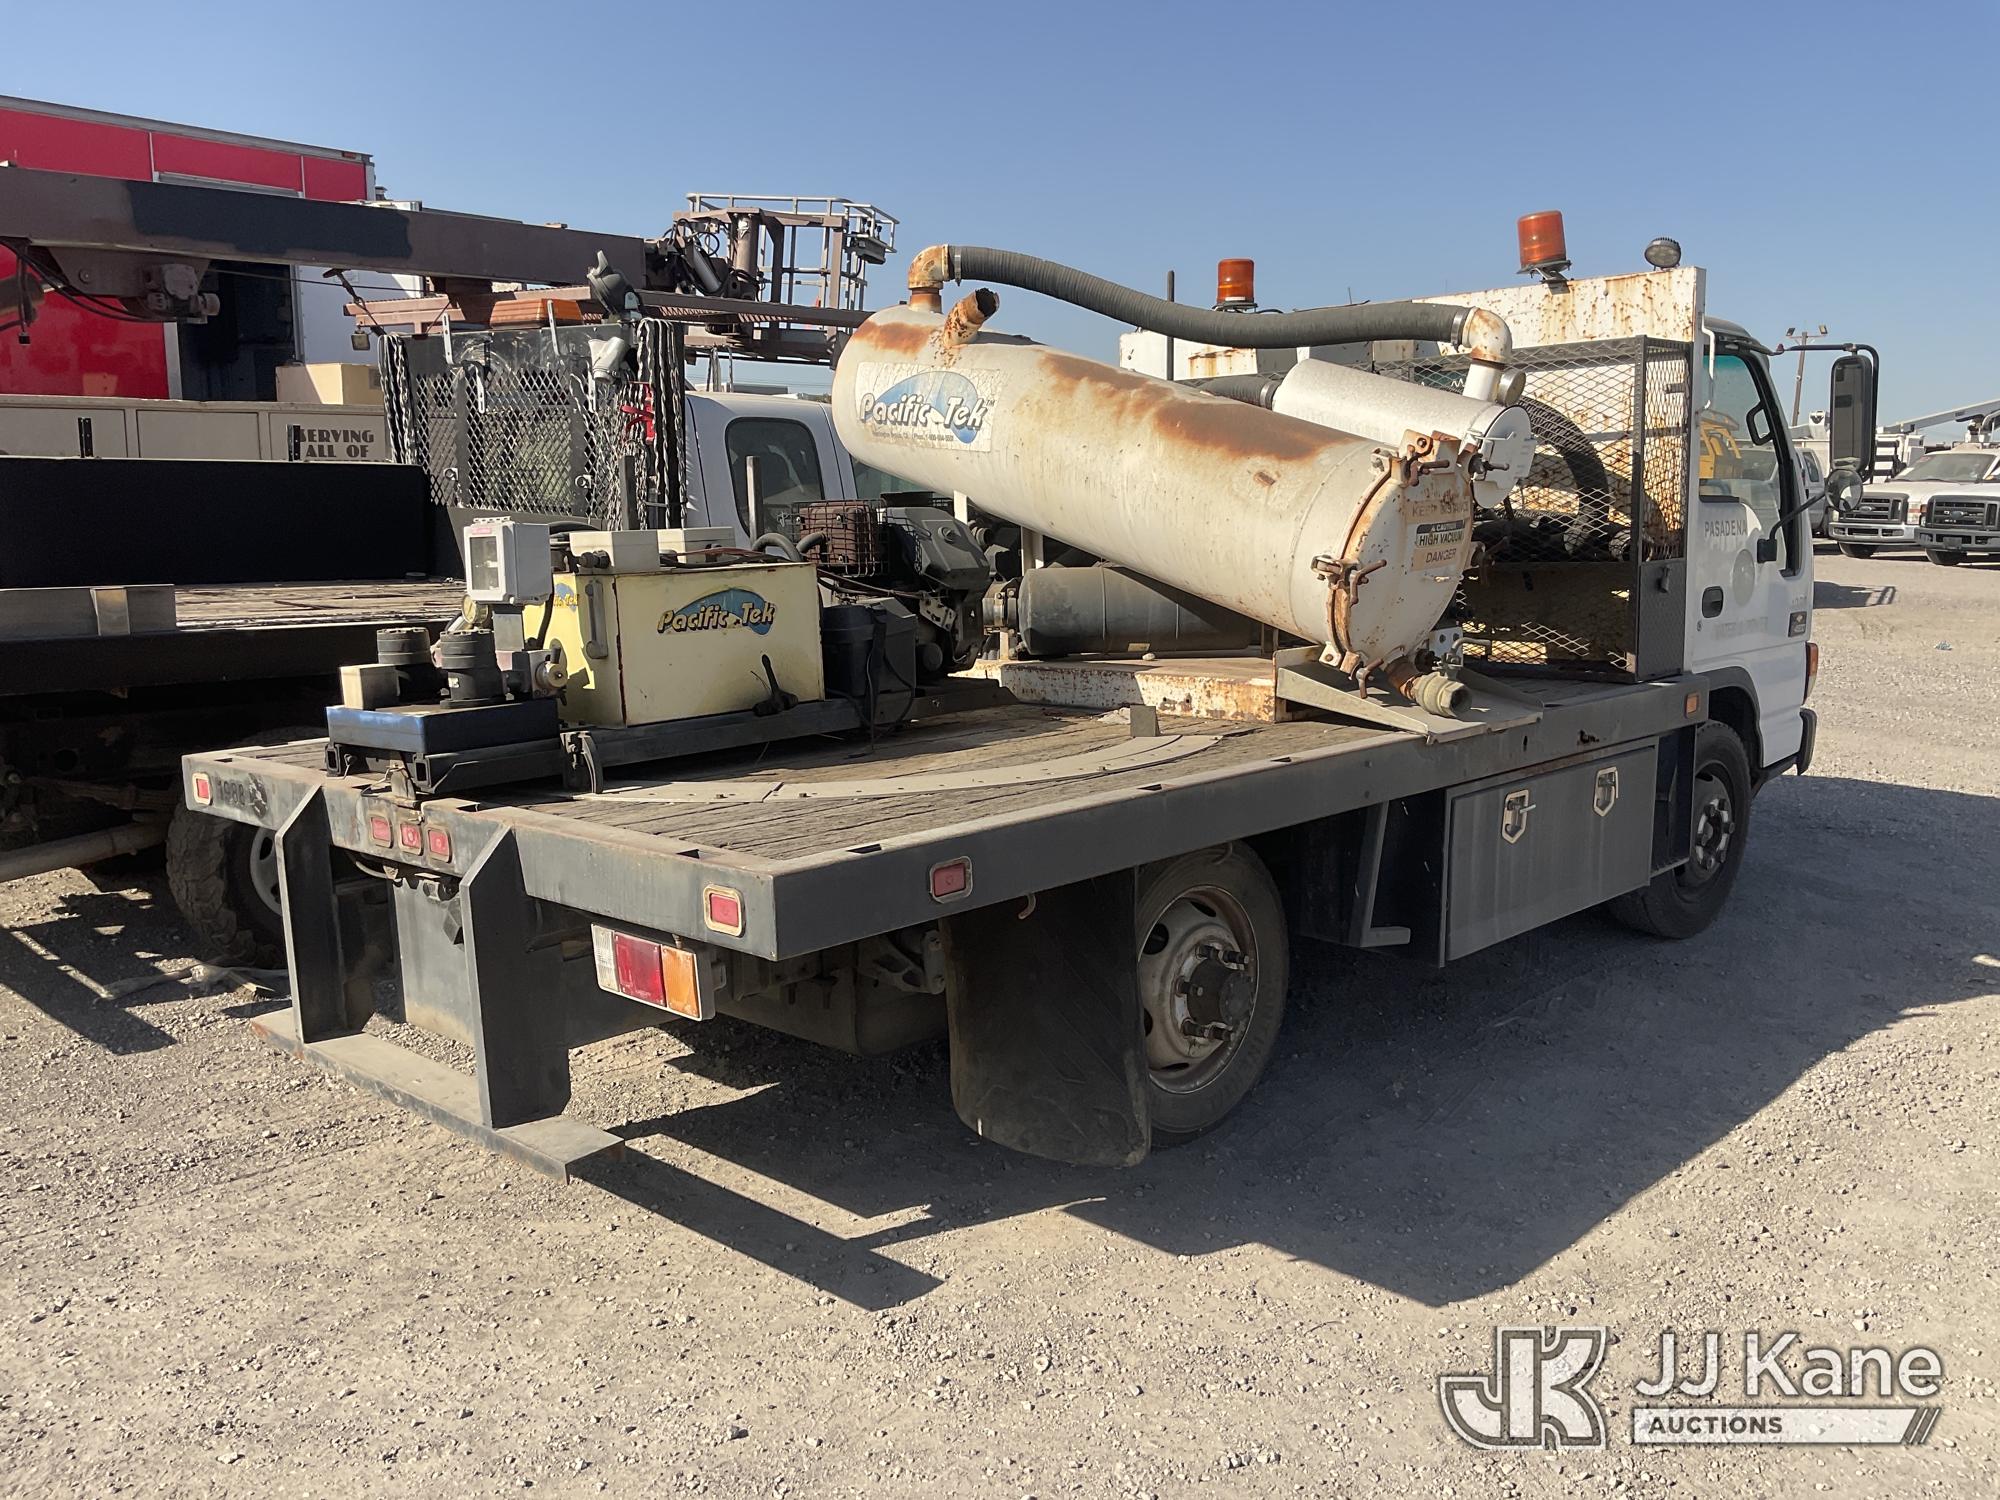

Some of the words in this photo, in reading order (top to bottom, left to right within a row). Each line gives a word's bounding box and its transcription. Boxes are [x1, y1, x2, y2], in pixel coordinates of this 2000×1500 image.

[860, 392, 932, 427] Pacific
[944, 396, 989, 431] Tek
[306, 444, 337, 458] ALL
[346, 444, 369, 458] OF
[1704, 519, 1748, 537] PASADENA
[1419, 533, 1440, 546] HIGH
[1425, 547, 1457, 563] DANGER
[657, 604, 730, 634] Pacific
[741, 601, 776, 626] Tek
